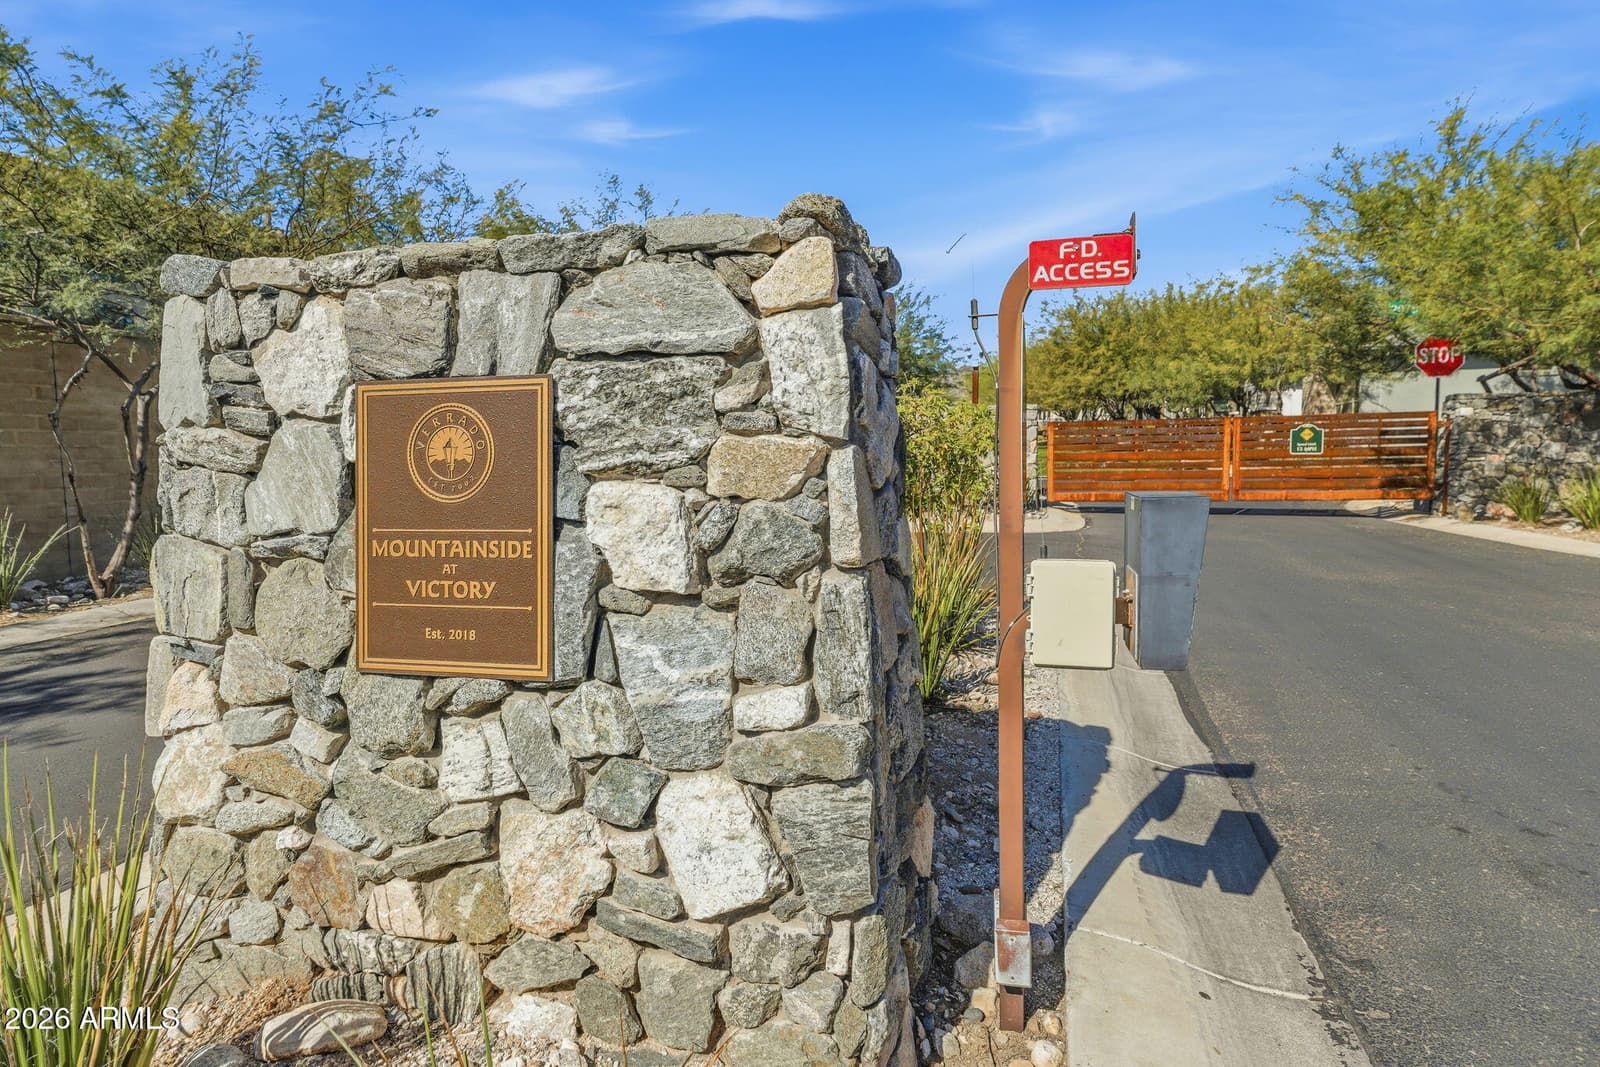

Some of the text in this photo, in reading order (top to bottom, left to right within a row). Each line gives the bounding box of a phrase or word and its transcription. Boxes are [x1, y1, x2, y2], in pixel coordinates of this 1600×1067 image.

[1033, 260, 1130, 282] ACCESS
[1419, 346, 1461, 364] STOP
[416, 412, 485, 450] VERRADO
[371, 540, 533, 559] MOUNTAINSIDE
[442, 564, 458, 574] AT
[405, 580, 496, 599] VICTORY
[425, 627, 476, 641] Est. 2018
